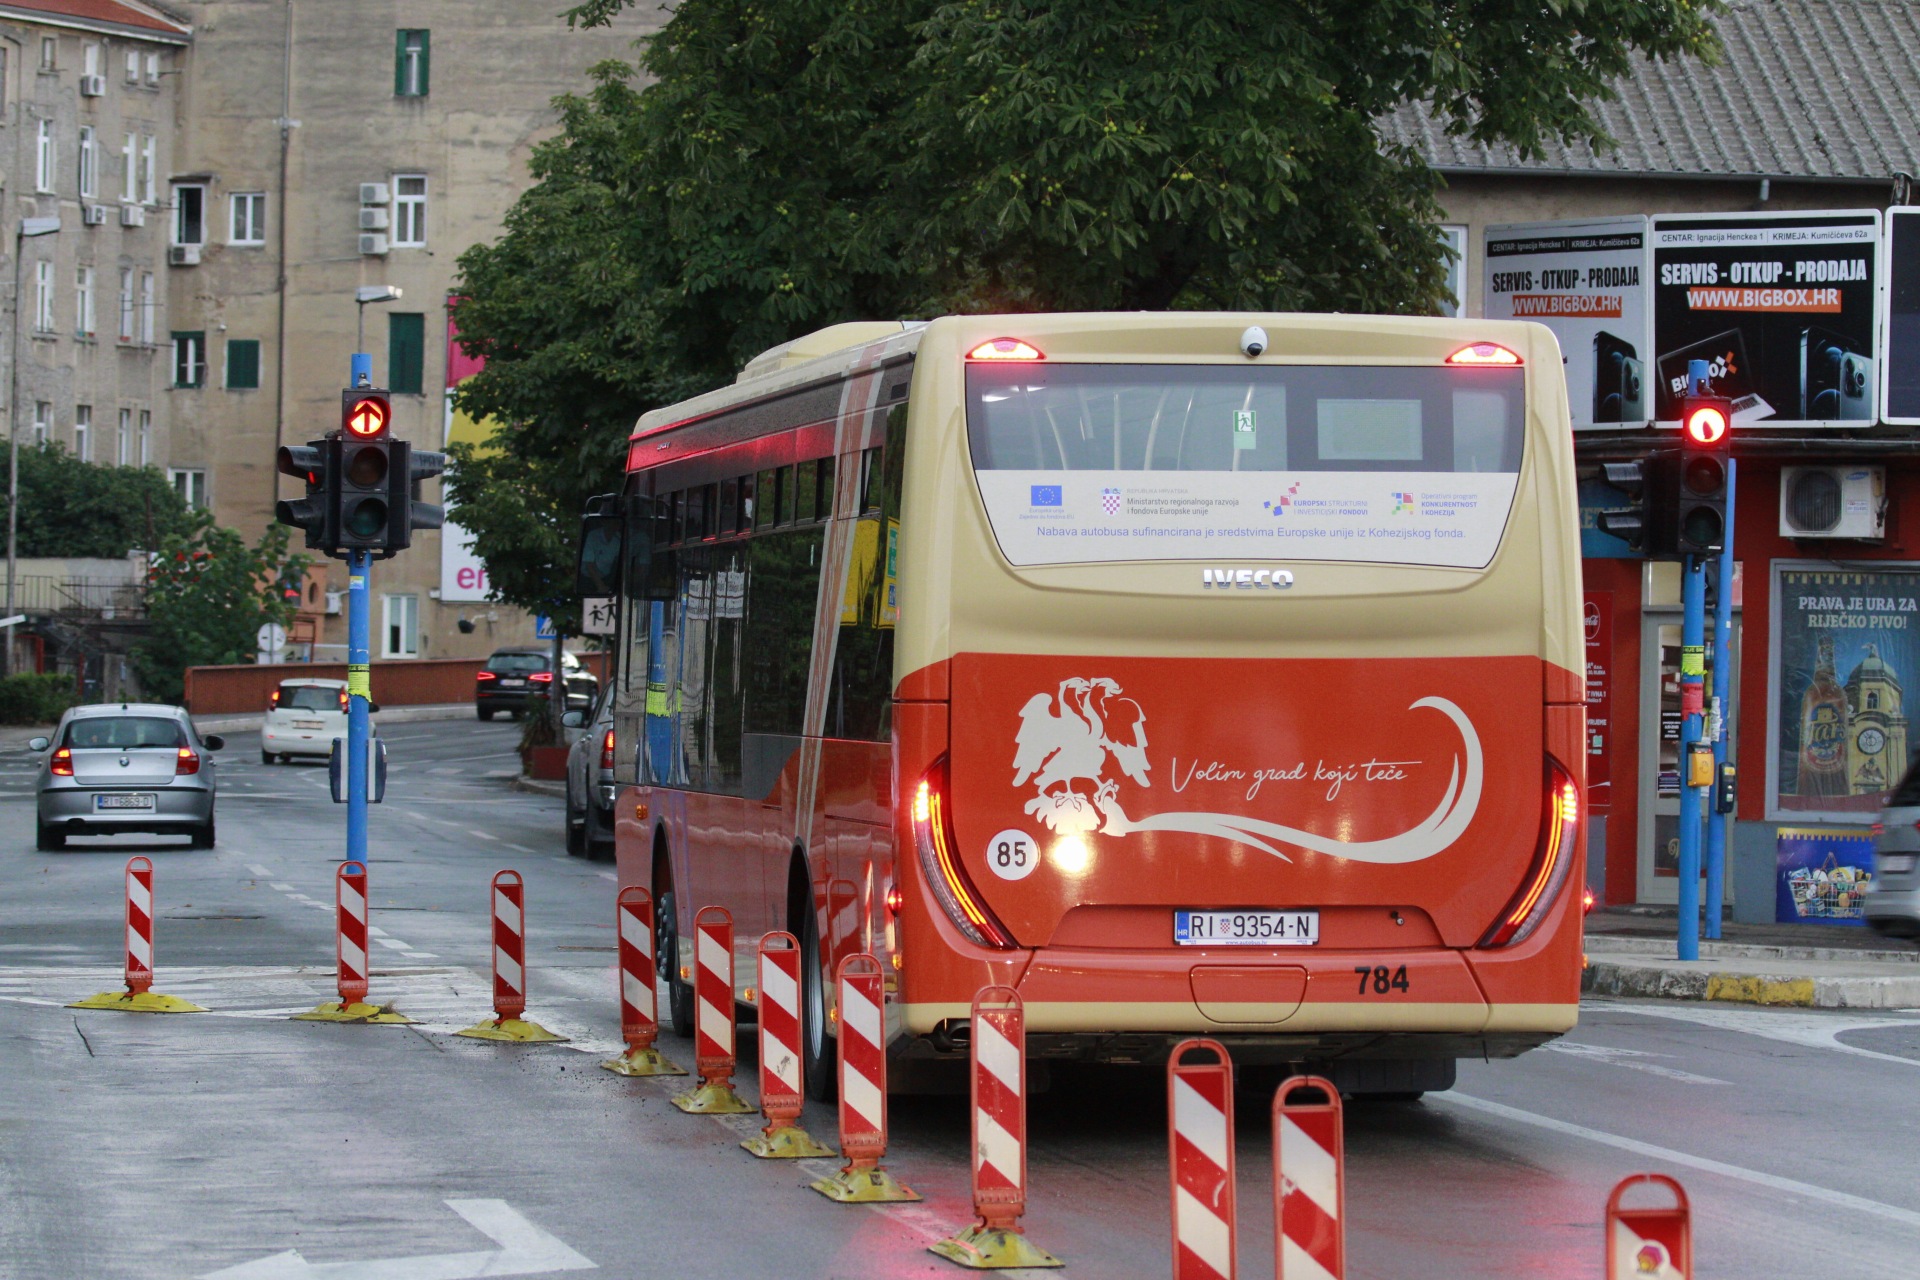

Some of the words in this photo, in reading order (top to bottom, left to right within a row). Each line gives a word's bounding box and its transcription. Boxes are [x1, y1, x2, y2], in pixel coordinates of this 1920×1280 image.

[1661, 234, 1695, 242] CENTAR:
[1696, 233, 1725, 243] Ignacija
[1726, 233, 1758, 241] Henckea
[1759, 232, 1763, 240] 1
[1772, 232, 1809, 241] KRIMEJA:
[1854, 229, 1868, 238] 62a
[1492, 244, 1516, 252] CENTAR:
[1571, 240, 1597, 249] KRIMEJA:
[1493, 271, 1532, 293] SERVIS
[1541, 269, 1579, 290] OTKUP
[1588, 266, 1640, 288] PRODAJA
[1661, 262, 1718, 285] SERVIS
[1730, 261, 1783, 284] OTKUP
[1795, 259, 1867, 283] PRODAJA
[1513, 296, 1620, 314] WWW.BIGBOX.HR
[1687, 288, 1838, 308] WWW.BIGBOX.HR
[1127, 498, 1169, 506] Ministarstvo
[1170, 498, 1213, 508] regionalnoga
[1214, 499, 1239, 508] razvoja
[1421, 493, 1452, 501] Operativni
[1453, 494, 1478, 502] program
[1130, 507, 1158, 515] fondova
[1159, 508, 1191, 517] Europske
[1192, 508, 1209, 517] unije
[1425, 509, 1455, 517] KOHEZIJA
[1037, 527, 1078, 537] Nabava
[1080, 527, 1129, 537] autobusa
[1132, 527, 1202, 538] sufinancirana
[1204, 528, 1214, 540] je
[1217, 528, 1274, 539] sredstvima
[1277, 528, 1326, 541] Europske
[1330, 528, 1354, 541] unije
[1357, 528, 1365, 539] iz
[1369, 528, 1431, 542] Kohezijskog
[1434, 529, 1466, 541] fonda.
[1203, 569, 1294, 590] IVECO
[1798, 596, 1845, 611] PRAVA
[1847, 597, 1863, 611] JE
[1866, 597, 1896, 612] URA
[1898, 598, 1918, 612] ZA
[1808, 611, 1867, 629] RIJEČKO
[1869, 615, 1907, 630] PIVO!
[1172, 757, 1245, 793] Volim
[1246, 762, 1307, 801] grad
[1313, 759, 1358, 801] koji
[1361, 758, 1422, 781] teče
[997, 841, 1027, 868] 85
[1192, 915, 1213, 937] RI
[1233, 915, 1309, 937] 9354-N
[1354, 965, 1410, 994] 784
